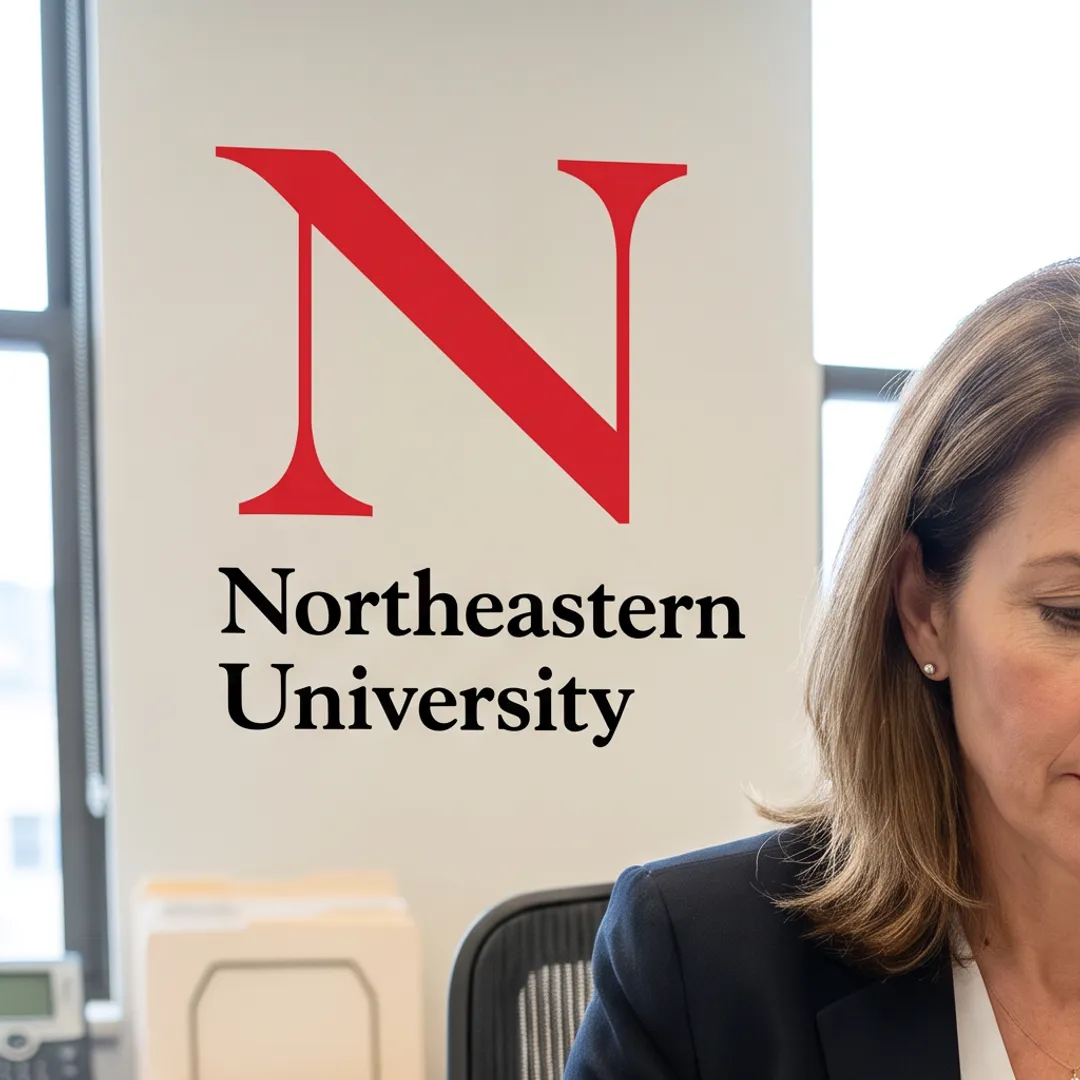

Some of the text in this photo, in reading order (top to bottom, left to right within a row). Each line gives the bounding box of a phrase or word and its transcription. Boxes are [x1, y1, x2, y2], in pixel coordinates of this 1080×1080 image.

[215, 146, 688, 524] N
[218, 567, 746, 640] Northeastern
[218, 662, 636, 748] University
